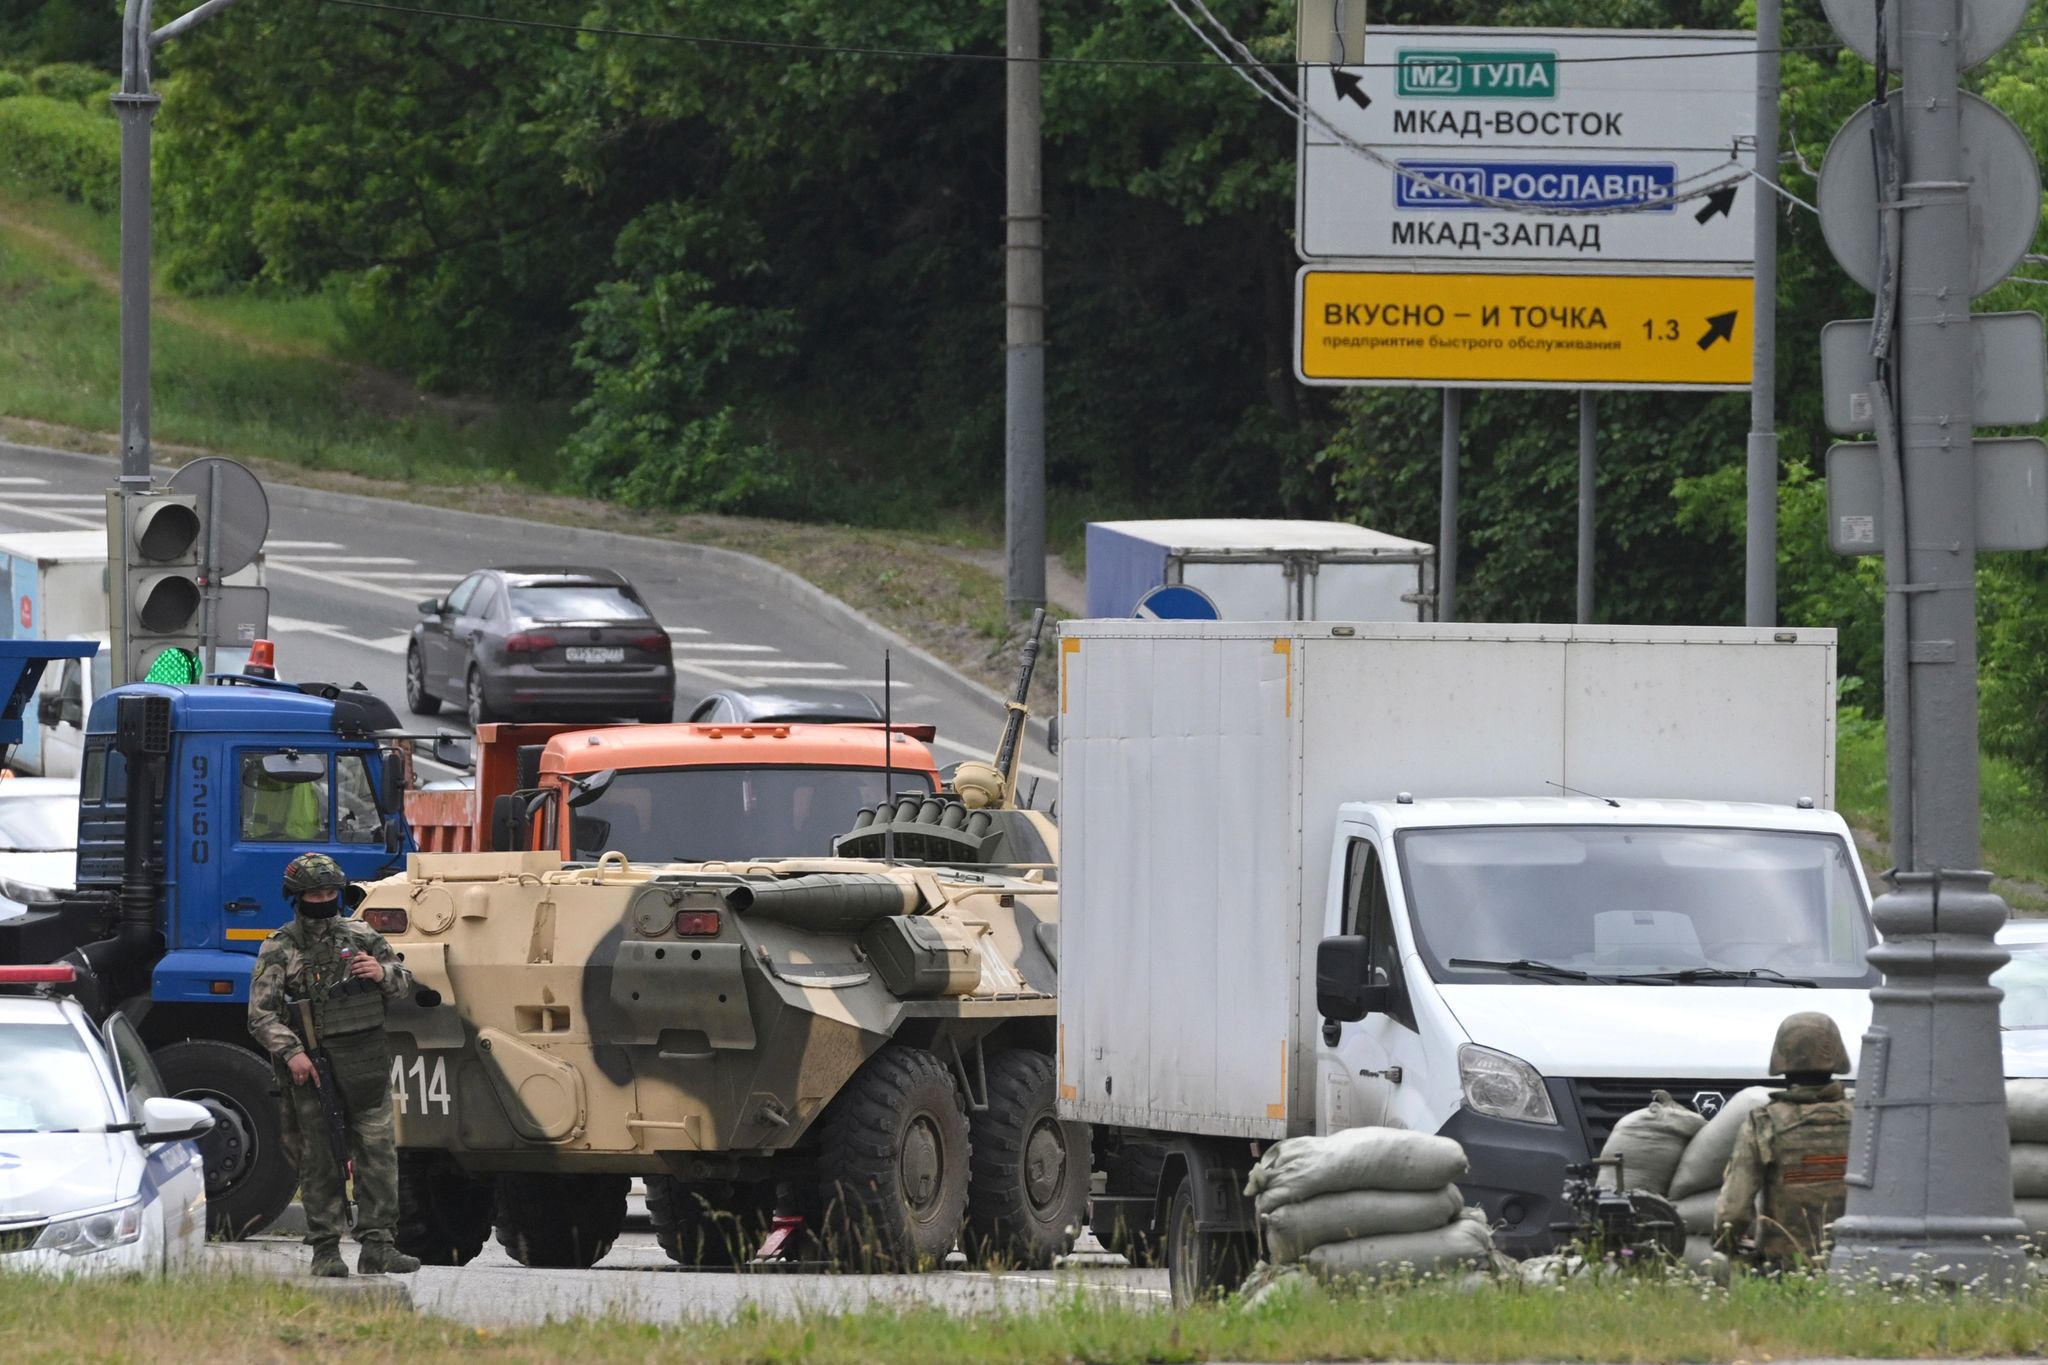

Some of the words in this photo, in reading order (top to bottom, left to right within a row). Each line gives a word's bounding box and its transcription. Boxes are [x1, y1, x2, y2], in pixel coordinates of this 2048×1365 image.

[1467, 61, 1551, 88] ТУЛА
[1393, 109, 1624, 139] МКАД-ВОСТОК
[1492, 173, 1669, 202] РОСЛАВЛЬ
[1391, 221, 1602, 252] МКАД-ЗАПАД
[1323, 303, 1445, 327] ВКУСНО
[1481, 305, 1500, 328] И
[1510, 305, 1608, 330] ТОЧКА
[1642, 318, 1681, 342] 1.3
[1322, 334, 1425, 350] предприятие
[1429, 334, 1504, 351] быстрого
[1508, 335, 1622, 352] обслуживания
[191, 755, 209, 865] 9260
[390, 1054, 452, 1116] 414
